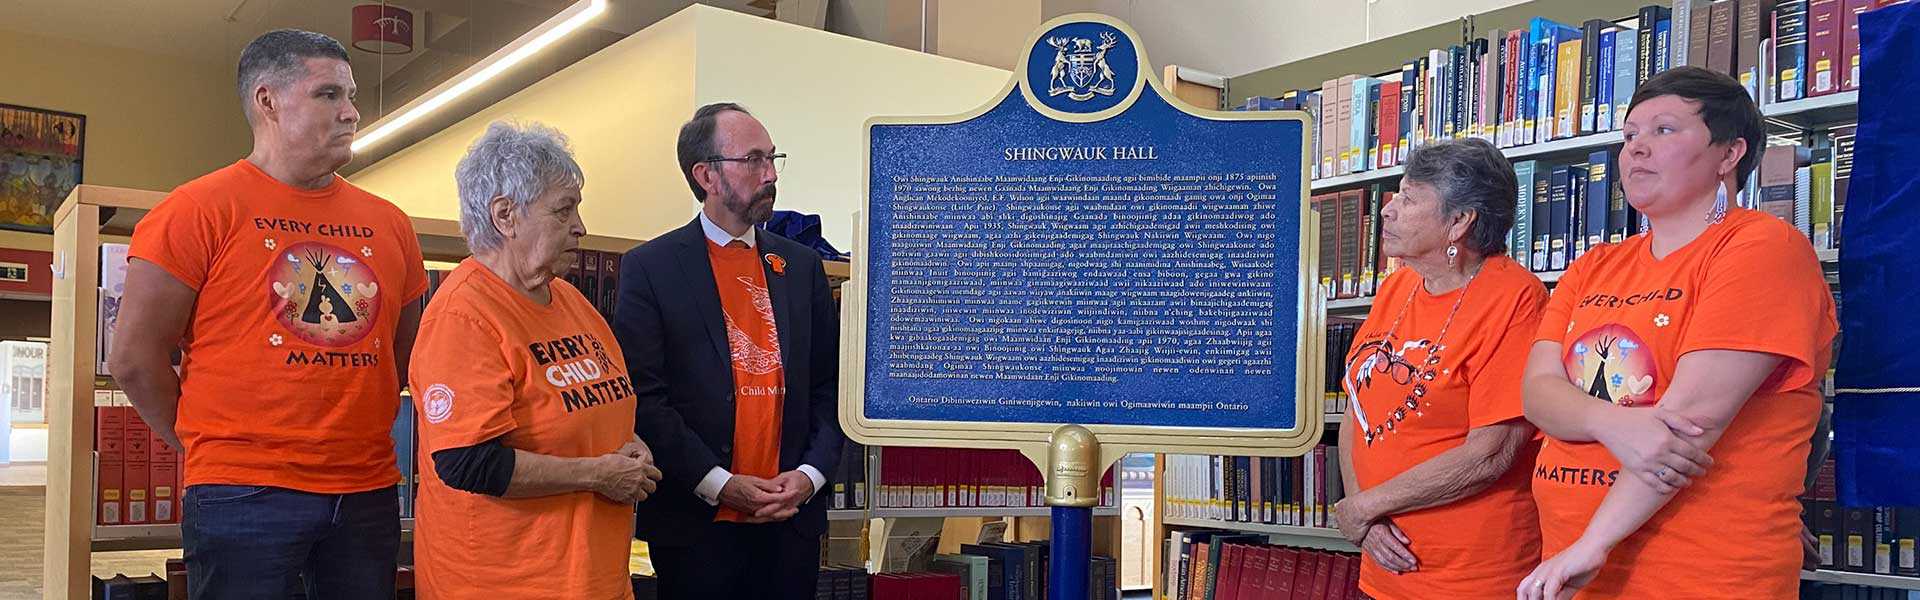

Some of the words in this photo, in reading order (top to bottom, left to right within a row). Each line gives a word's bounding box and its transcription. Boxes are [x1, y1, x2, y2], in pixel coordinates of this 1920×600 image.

[1004, 148, 1106, 160] SHINGWAUK
[1113, 146, 1158, 160] HALL
[910, 175, 948, 184] Shingwauk
[995, 175, 1047, 183] Maamwidaang
[1065, 175, 1121, 183] Gikinomaading
[1027, 184, 1081, 193] Maamwidaang
[1101, 184, 1158, 192] Gikinomaading
[892, 194, 923, 202] Anglican
[1246, 193, 1275, 201] Ogimaa
[1518, 184, 1526, 220] MODERN
[892, 204, 947, 212] Shingwaukonse
[254, 217, 312, 234] EVERY
[318, 223, 374, 238] CHILD
[983, 222, 1004, 230] 1935,
[1007, 222, 1048, 230] Shingwauk
[1097, 231, 1140, 240] Shingwauk
[935, 241, 987, 249] Maamwidaang
[1009, 241, 1066, 249] Gikinomaading
[1157, 270, 1191, 278] biboon,
[1247, 270, 1273, 279] gikino
[1095, 317, 1113, 325] nigo
[1075, 336, 1133, 345] Gikinomaading
[1158, 337, 1179, 345] 1970,
[529, 334, 590, 365] EVERY
[1048, 345, 1091, 354] Shingwauk
[1095, 346, 1114, 354] Agaa
[286, 350, 378, 368] MATTERS
[945, 353, 982, 362] Shingwauk
[943, 362, 973, 371] Ogimaa
[982, 363, 1041, 372] Shingwaukonse
[546, 358, 601, 388] CHILD
[1061, 373, 1119, 382] Gikinomaading.
[560, 376, 633, 412] MATTER
[740, 386, 765, 396] Child
[1120, 400, 1176, 409] Ogimaawiwin
[1178, 402, 1213, 411] maampii
[1216, 402, 1248, 410] Ontario
[1536, 464, 1620, 487] MATTERS
